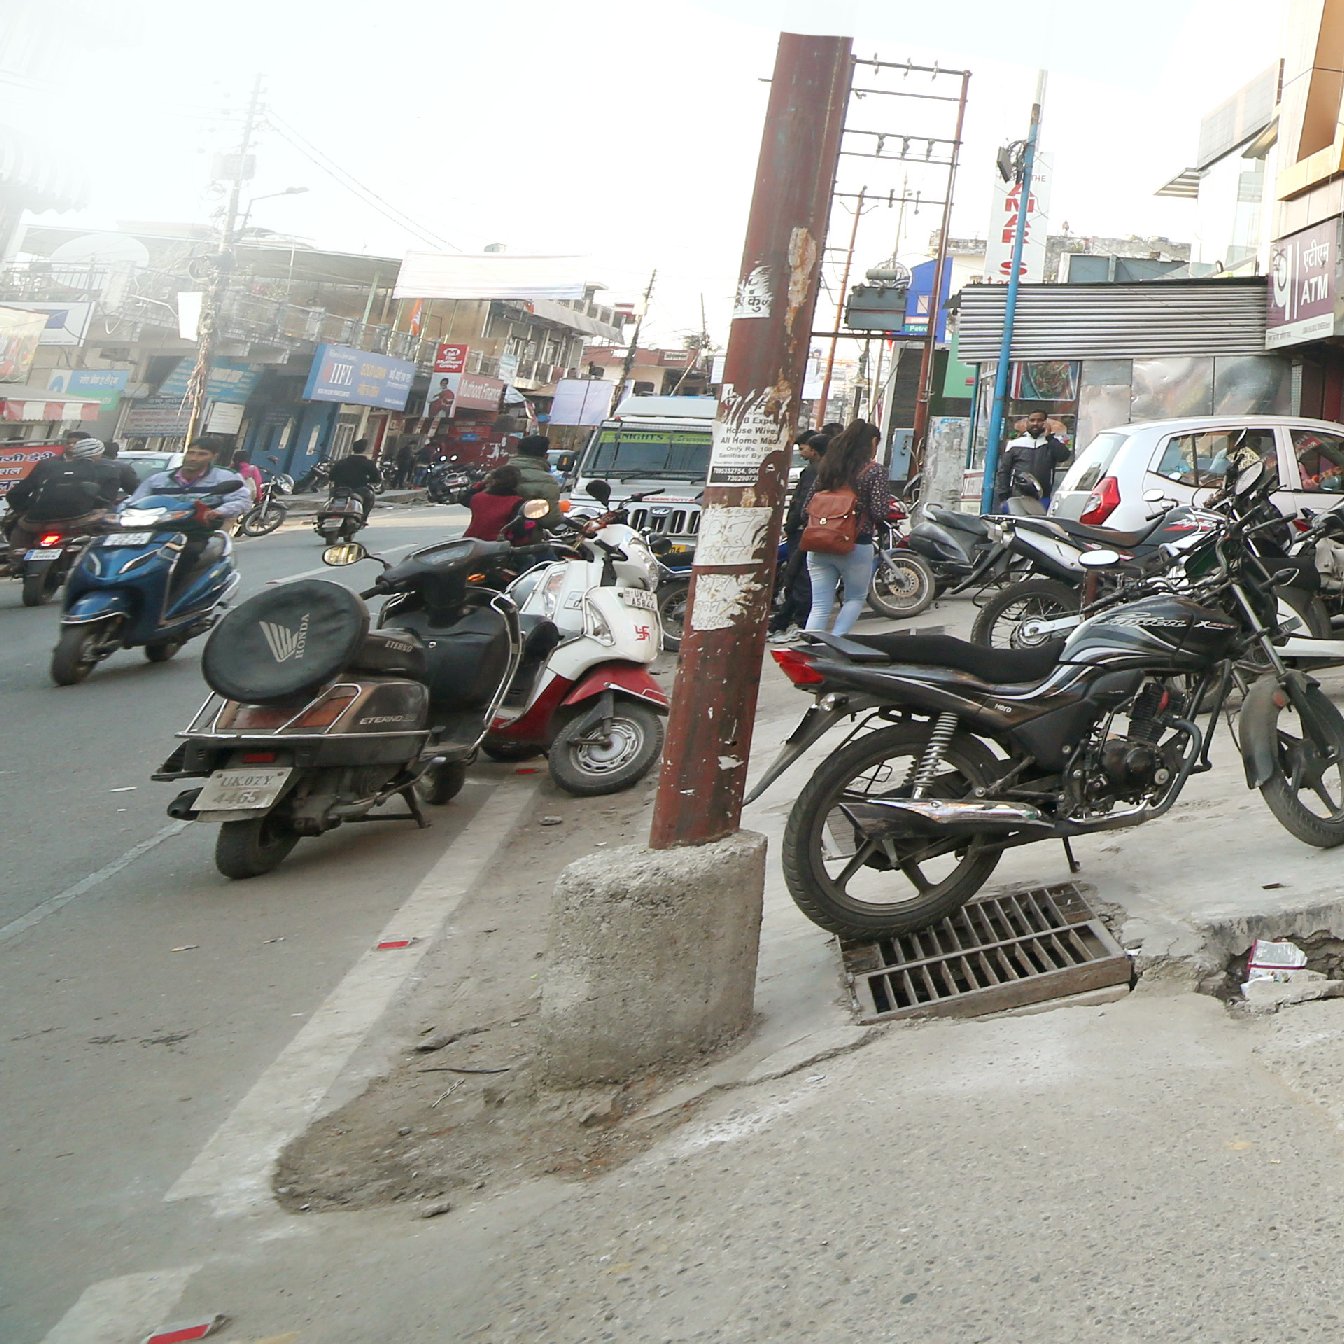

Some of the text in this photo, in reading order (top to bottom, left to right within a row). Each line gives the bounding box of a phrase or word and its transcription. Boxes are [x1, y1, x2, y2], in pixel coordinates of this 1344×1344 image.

[1303, 239, 1330, 273] एटीएम
[1301, 273, 1328, 306] ATM
[329, 363, 353, 386] IIFL
[295, 612, 311, 660] HONDA
